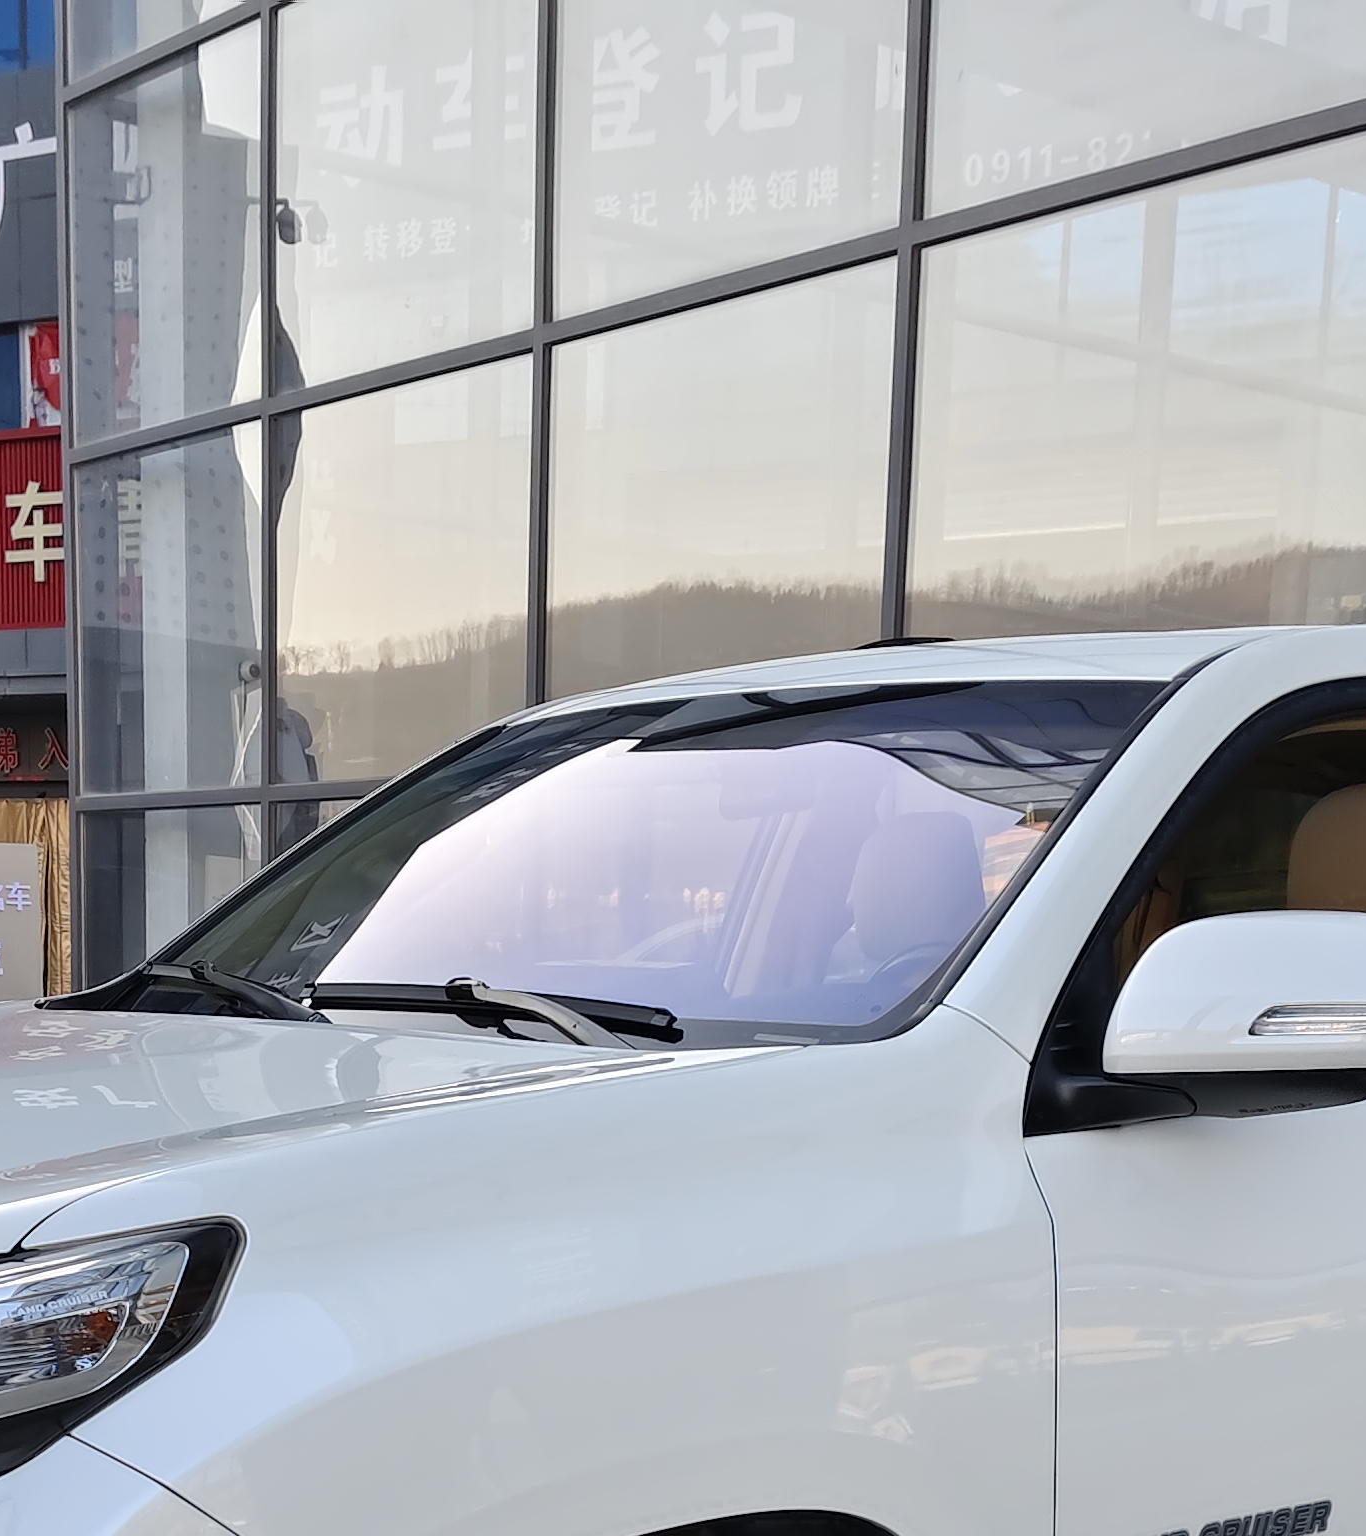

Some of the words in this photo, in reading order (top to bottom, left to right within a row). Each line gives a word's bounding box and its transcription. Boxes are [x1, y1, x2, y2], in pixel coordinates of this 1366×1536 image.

[962, 128, 1151, 188] 0911-82
[362, 215, 473, 262] 转移登
[10, 1303, 46, 1318] LAND
[48, 1289, 108, 1311] CRUISER
